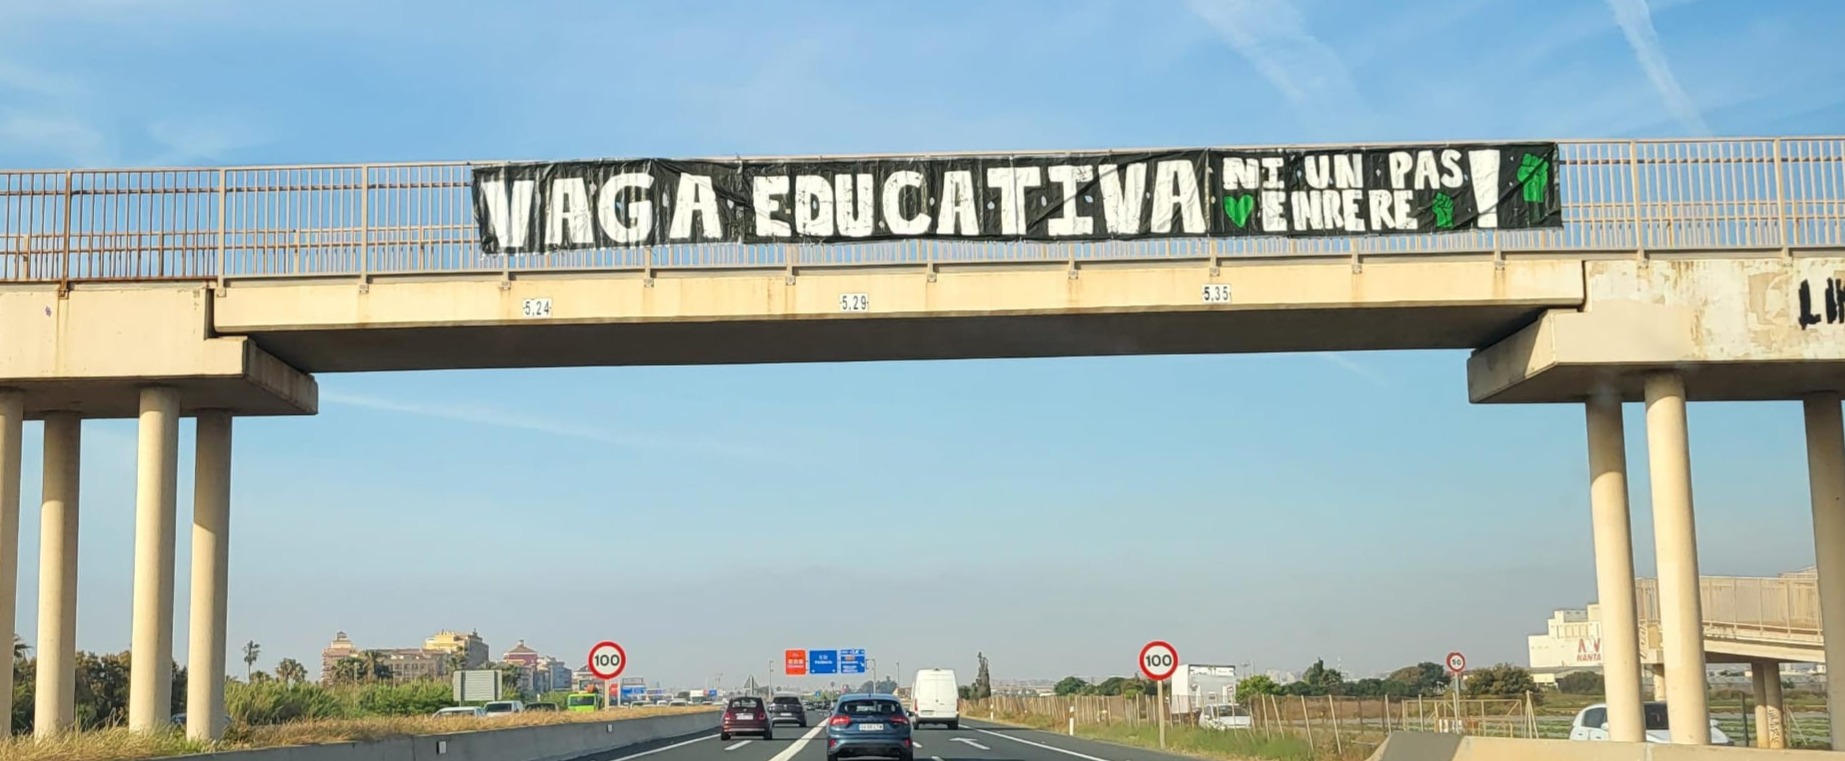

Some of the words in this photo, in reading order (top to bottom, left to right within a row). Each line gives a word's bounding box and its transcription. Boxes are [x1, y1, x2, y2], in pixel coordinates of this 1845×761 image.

[1223, 157, 1285, 189] NI
[1304, 153, 1364, 189] UN
[1389, 150, 1463, 189] PAS
[481, 172, 723, 247] VAGA
[753, 159, 1207, 237] EDUCATIVA
[1262, 189, 1418, 232] ENRERE
[594, 654, 621, 667] 100
[1146, 654, 1172, 667] 100
